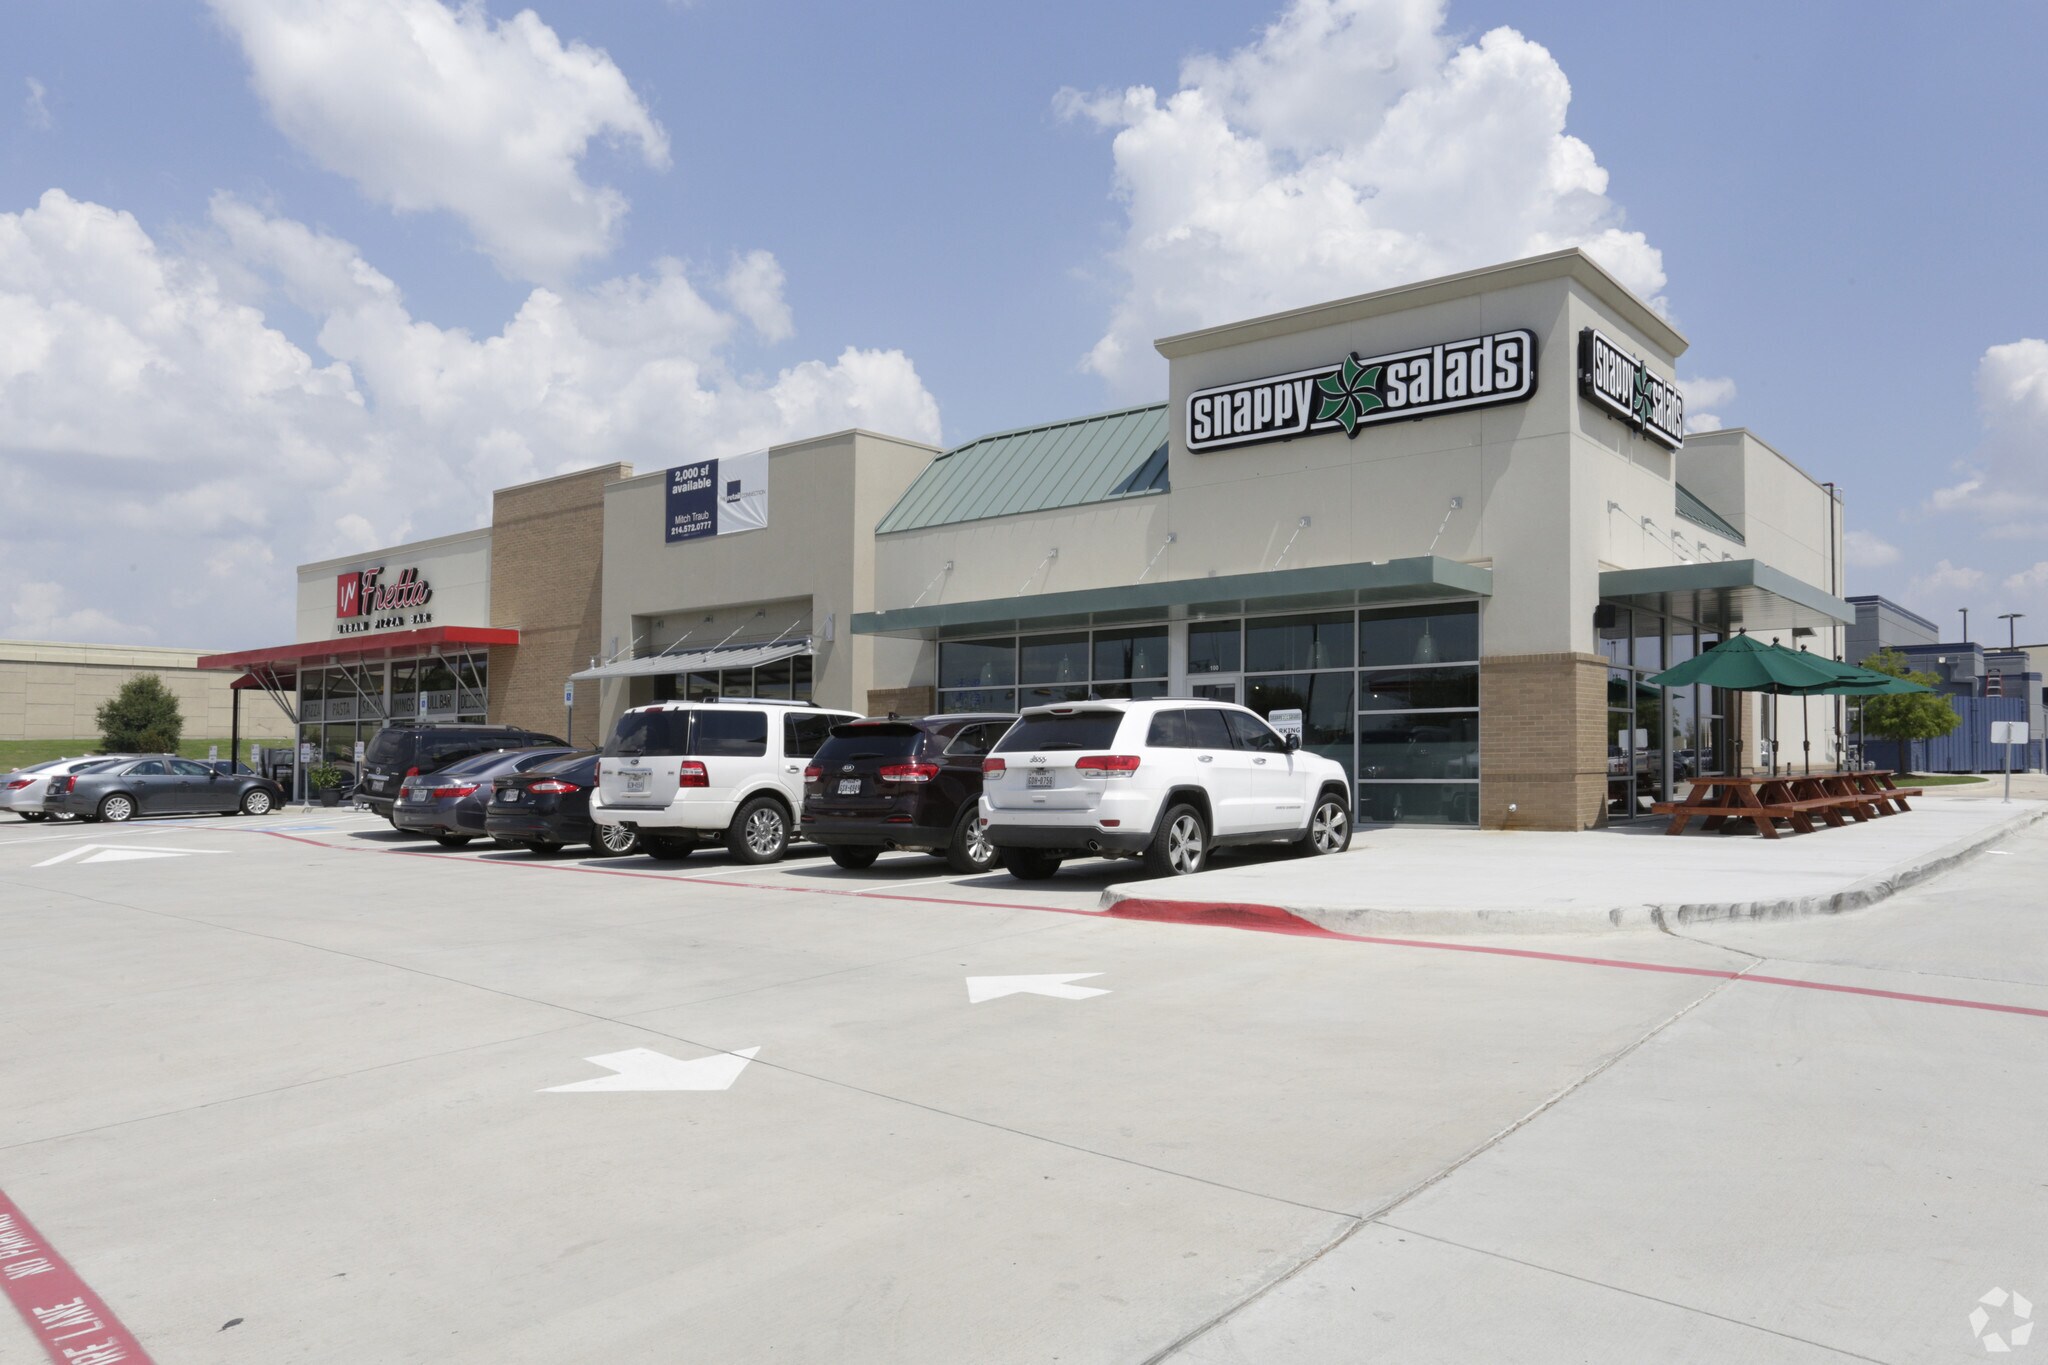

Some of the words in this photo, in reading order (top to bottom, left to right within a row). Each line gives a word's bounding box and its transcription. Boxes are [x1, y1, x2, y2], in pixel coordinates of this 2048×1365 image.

[1193, 378, 1314, 440] snappy
[1386, 336, 1520, 408] salads
[1596, 339, 1635, 415] snappy
[1652, 379, 1682, 440] salads
[675, 467, 699, 482] 2,000
[701, 465, 709, 476] sf
[672, 478, 711, 494] available
[675, 514, 691, 524] Mitch
[693, 511, 709, 521] Traub
[671, 521, 711, 535] 214.572.0777
[362, 567, 430, 616] Fretta
[337, 623, 366, 634] URBAN
[374, 616, 401, 629] PIZZA
[410, 612, 429, 625] BAR
[332, 702, 350, 716] PASTA
[394, 698, 415, 712] WINGS
[4, 1256, 55, 1280] NO
[32, 1296, 105, 1341] LANE
